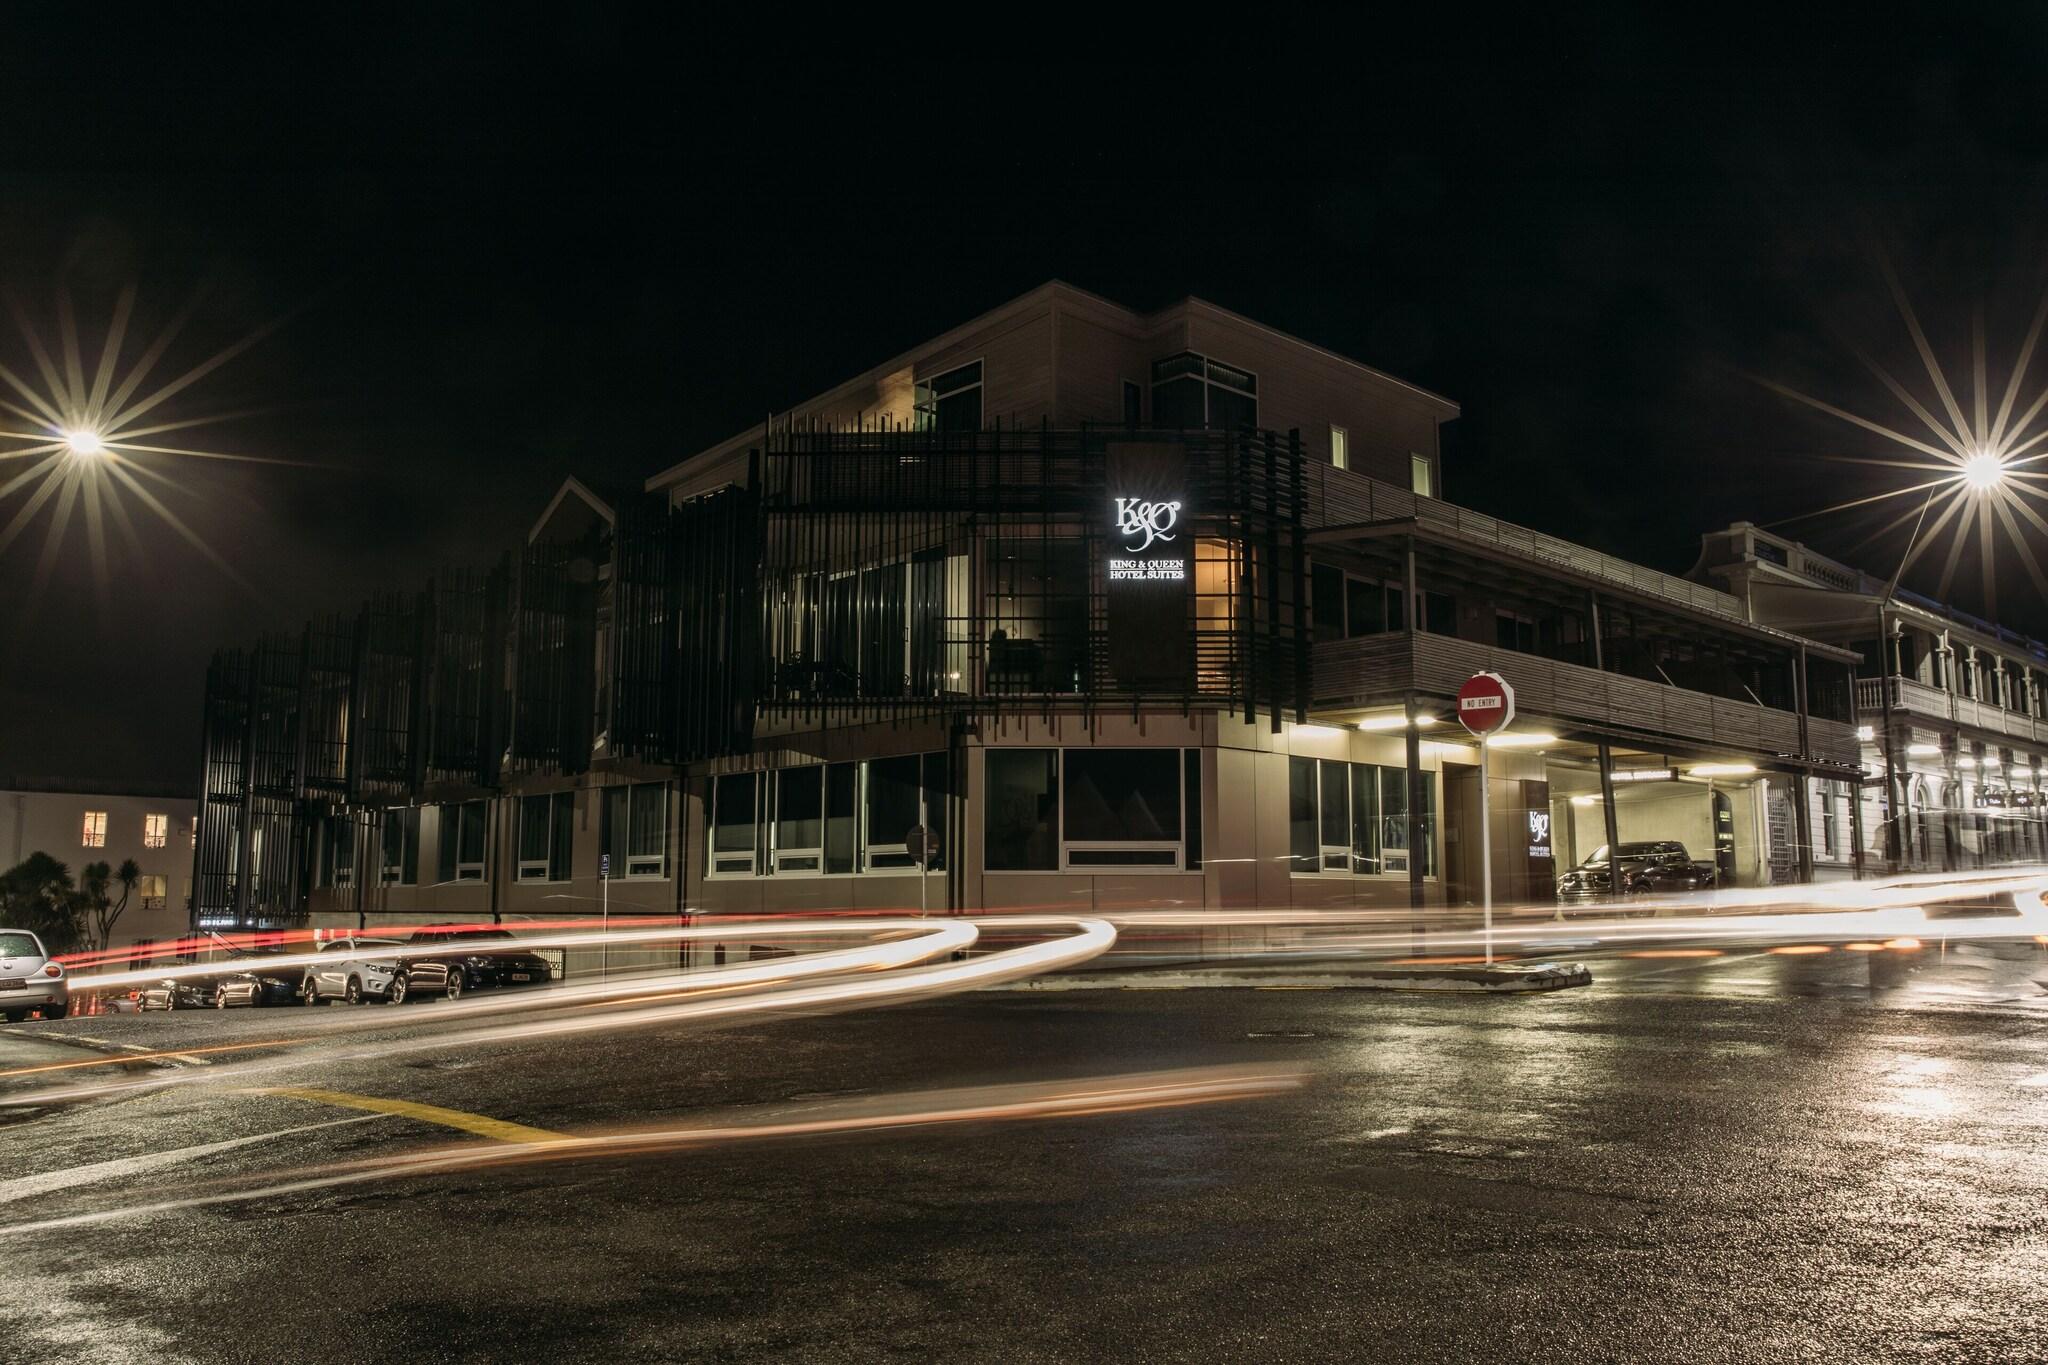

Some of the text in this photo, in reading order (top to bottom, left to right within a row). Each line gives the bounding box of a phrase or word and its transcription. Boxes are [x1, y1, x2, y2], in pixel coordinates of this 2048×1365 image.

[1115, 498, 1181, 552] K&Q
[1110, 560, 1185, 571] KING & QUEEN
[1110, 571, 1185, 580] HOTEL SUITES
[1466, 698, 1496, 708] NO ENTRY
